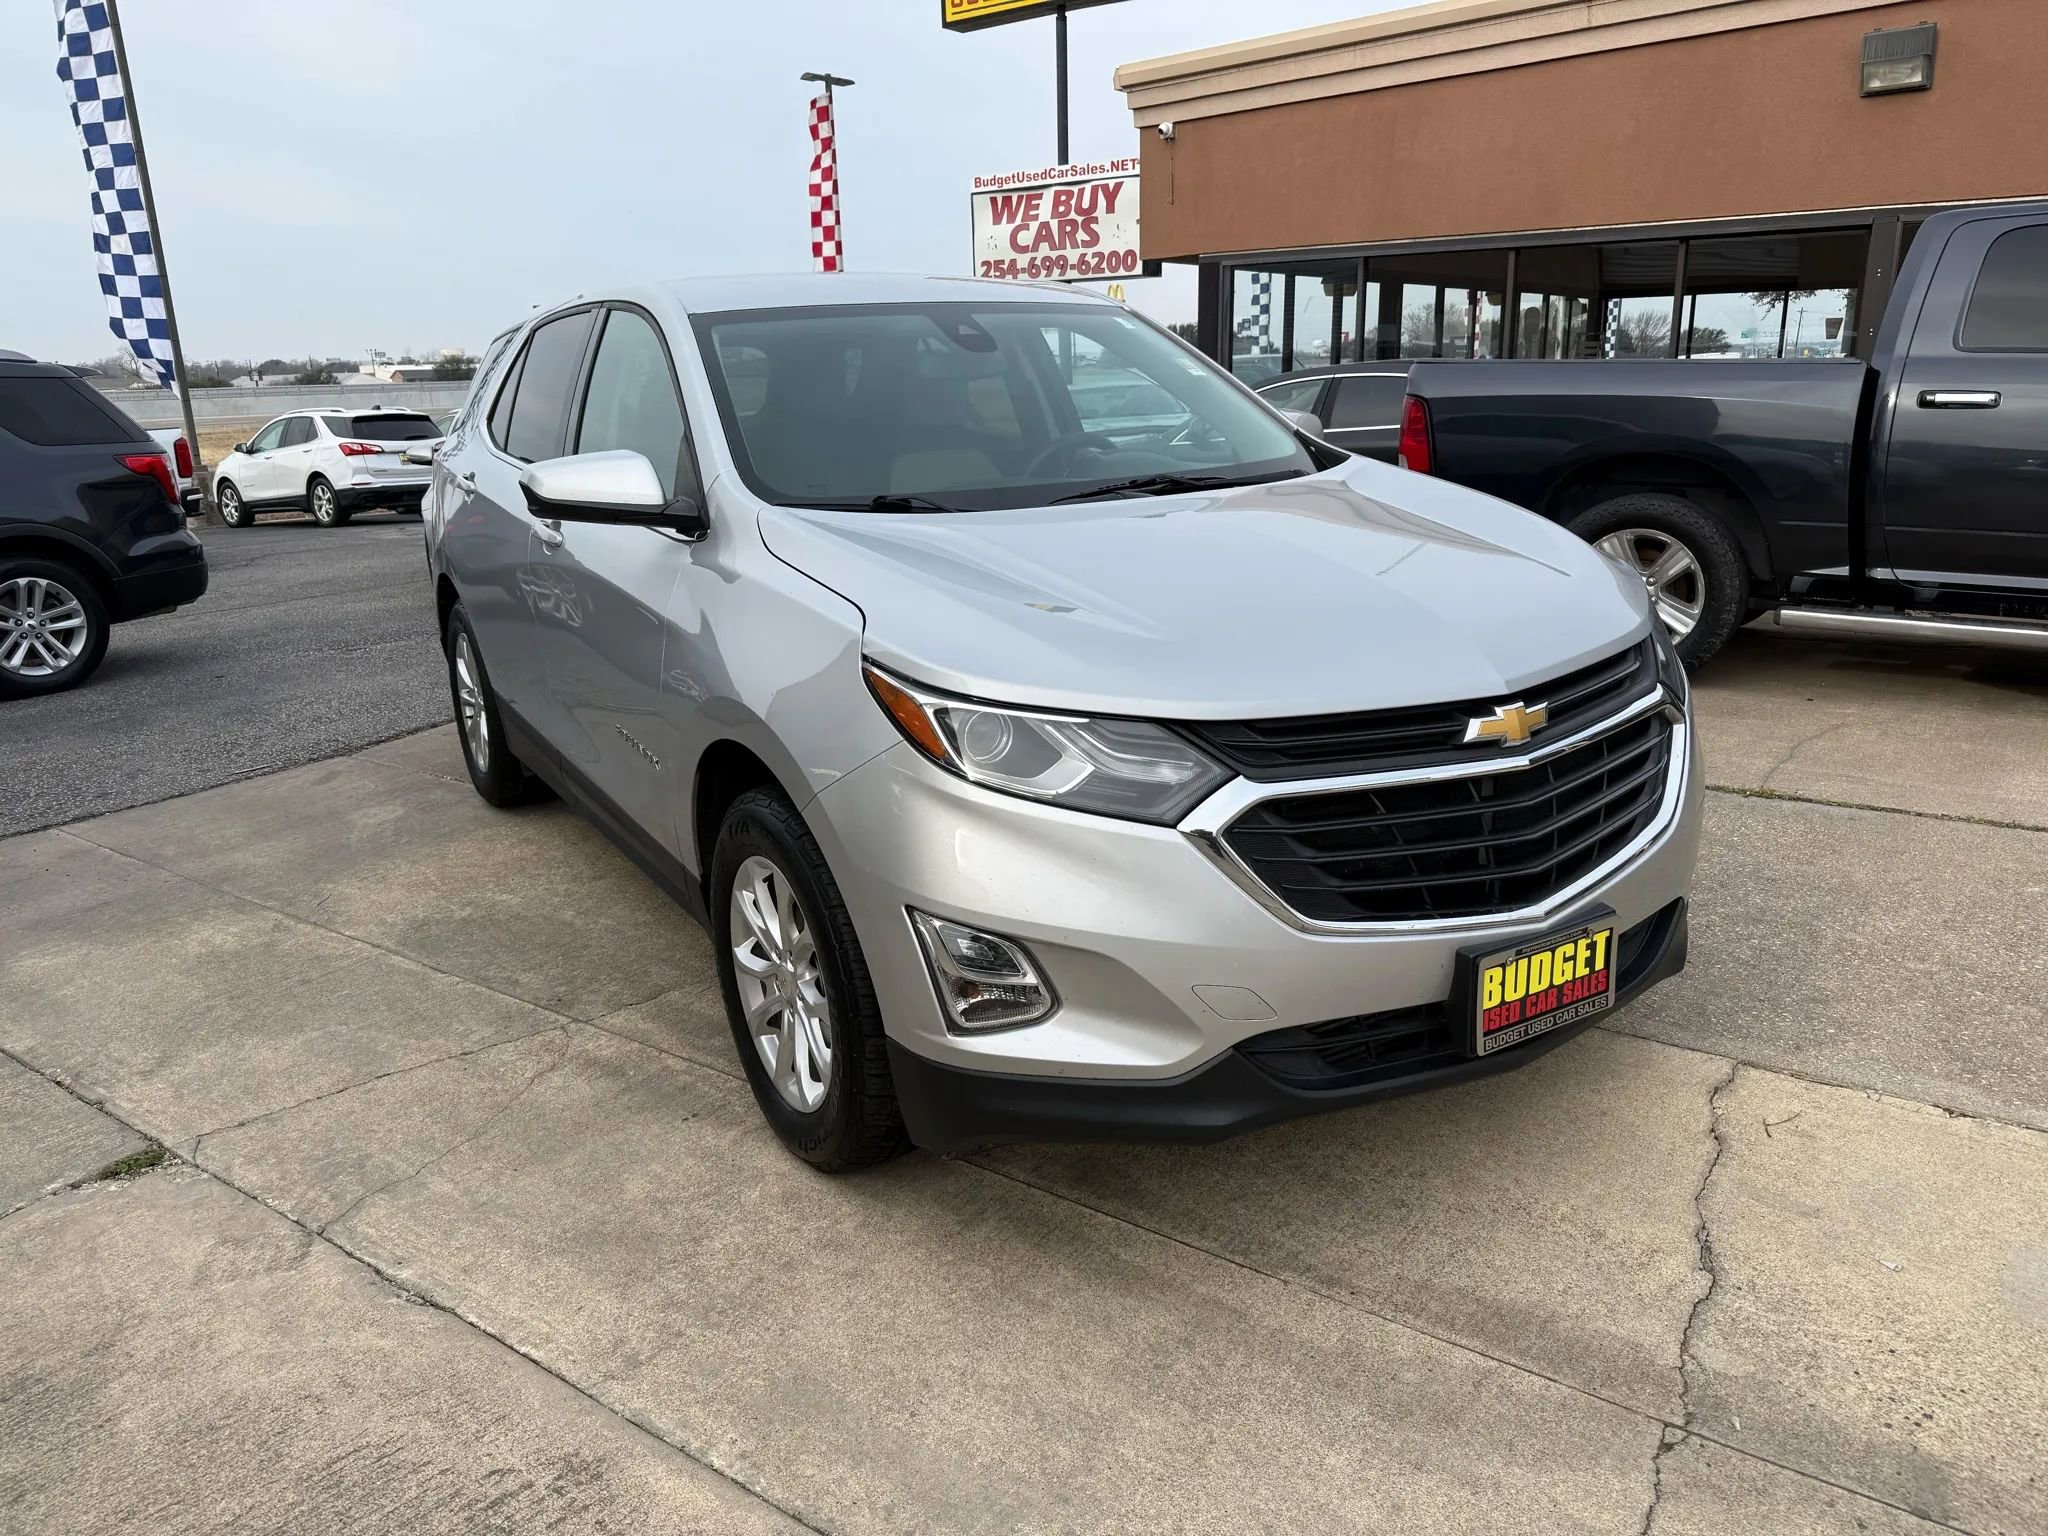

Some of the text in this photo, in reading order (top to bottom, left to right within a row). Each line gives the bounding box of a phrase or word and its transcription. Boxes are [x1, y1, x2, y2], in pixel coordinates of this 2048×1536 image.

[974, 158, 1137, 189] BudgetUsedCarSales.NET
[989, 181, 1124, 225] WE BUY
[1009, 216, 1100, 254] CARS
[981, 249, 1137, 280] 254-699-6200
[1483, 930, 1610, 1009] BUDGET
[1526, 988, 1557, 1018] CAR
[1563, 970, 1608, 1005] SALES
[1485, 997, 1607, 1051] BUDGET USED CAR SALES
